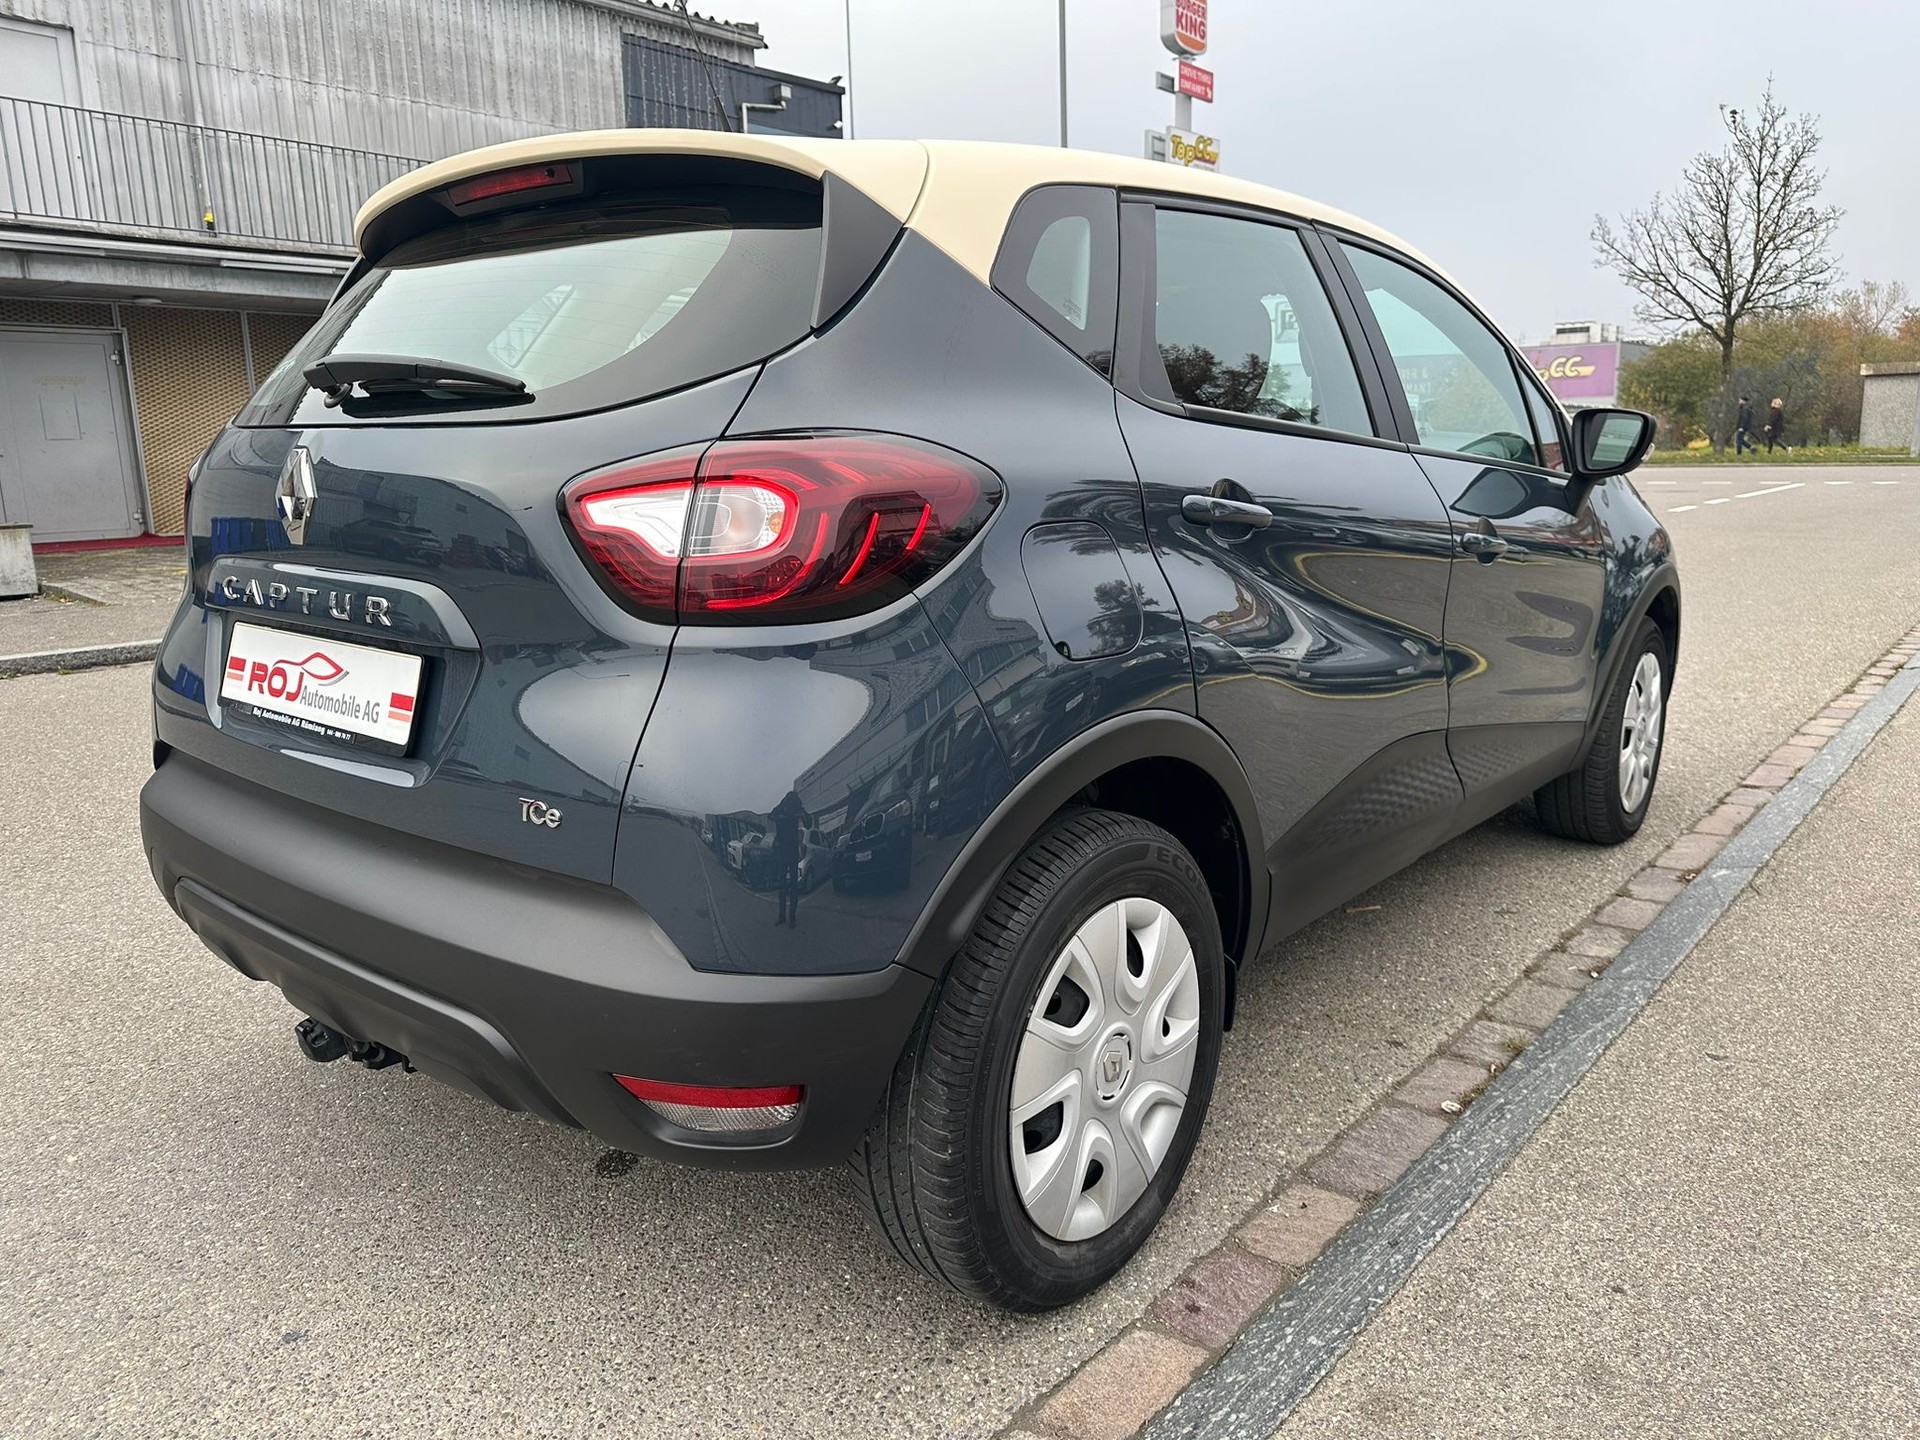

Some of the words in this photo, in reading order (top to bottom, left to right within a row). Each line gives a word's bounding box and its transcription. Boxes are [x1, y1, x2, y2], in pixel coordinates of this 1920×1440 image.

[1176, 0, 1206, 19] BURGER
[1176, 9, 1206, 40] KING
[223, 576, 392, 627] CAPTUR
[248, 661, 304, 702] ROJ
[252, 707, 263, 718] Roj
[262, 709, 292, 725] Automobile
[291, 717, 301, 727] AG
[300, 685, 361, 719] Automobile
[362, 699, 380, 724] AG
[519, 797, 562, 829] TCe
